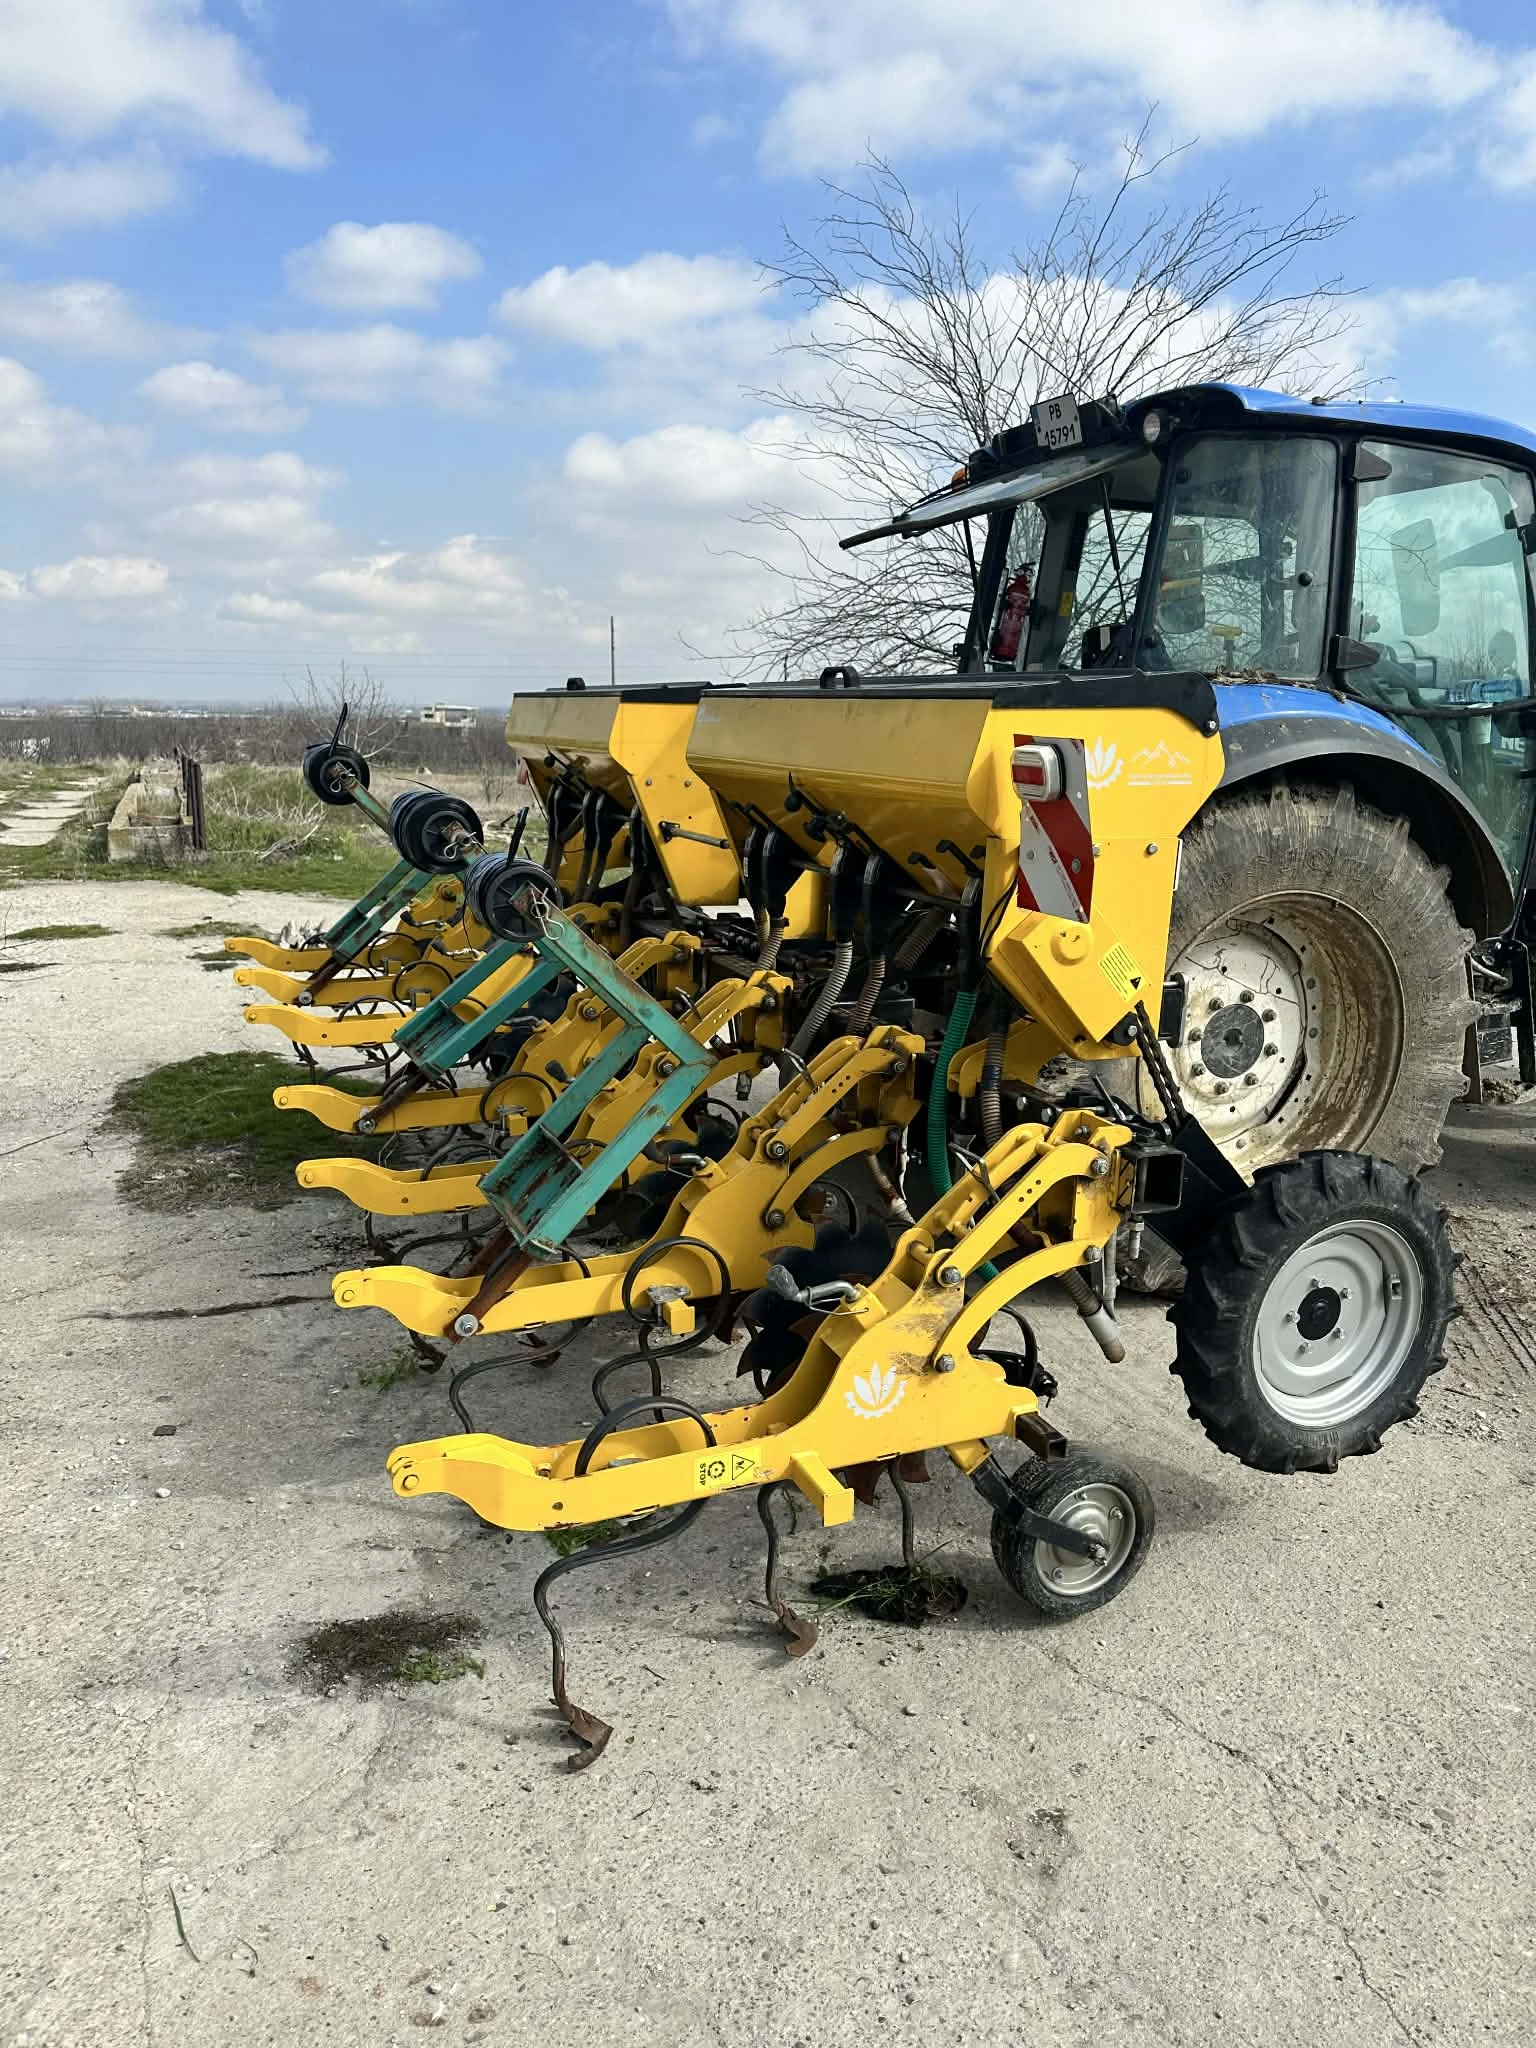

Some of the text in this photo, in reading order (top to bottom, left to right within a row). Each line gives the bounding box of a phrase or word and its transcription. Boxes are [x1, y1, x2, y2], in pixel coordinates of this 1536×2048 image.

[1048, 403, 1062, 421] PB
[1044, 423, 1076, 447] 15791
[699, 1462, 707, 1486] STOP
